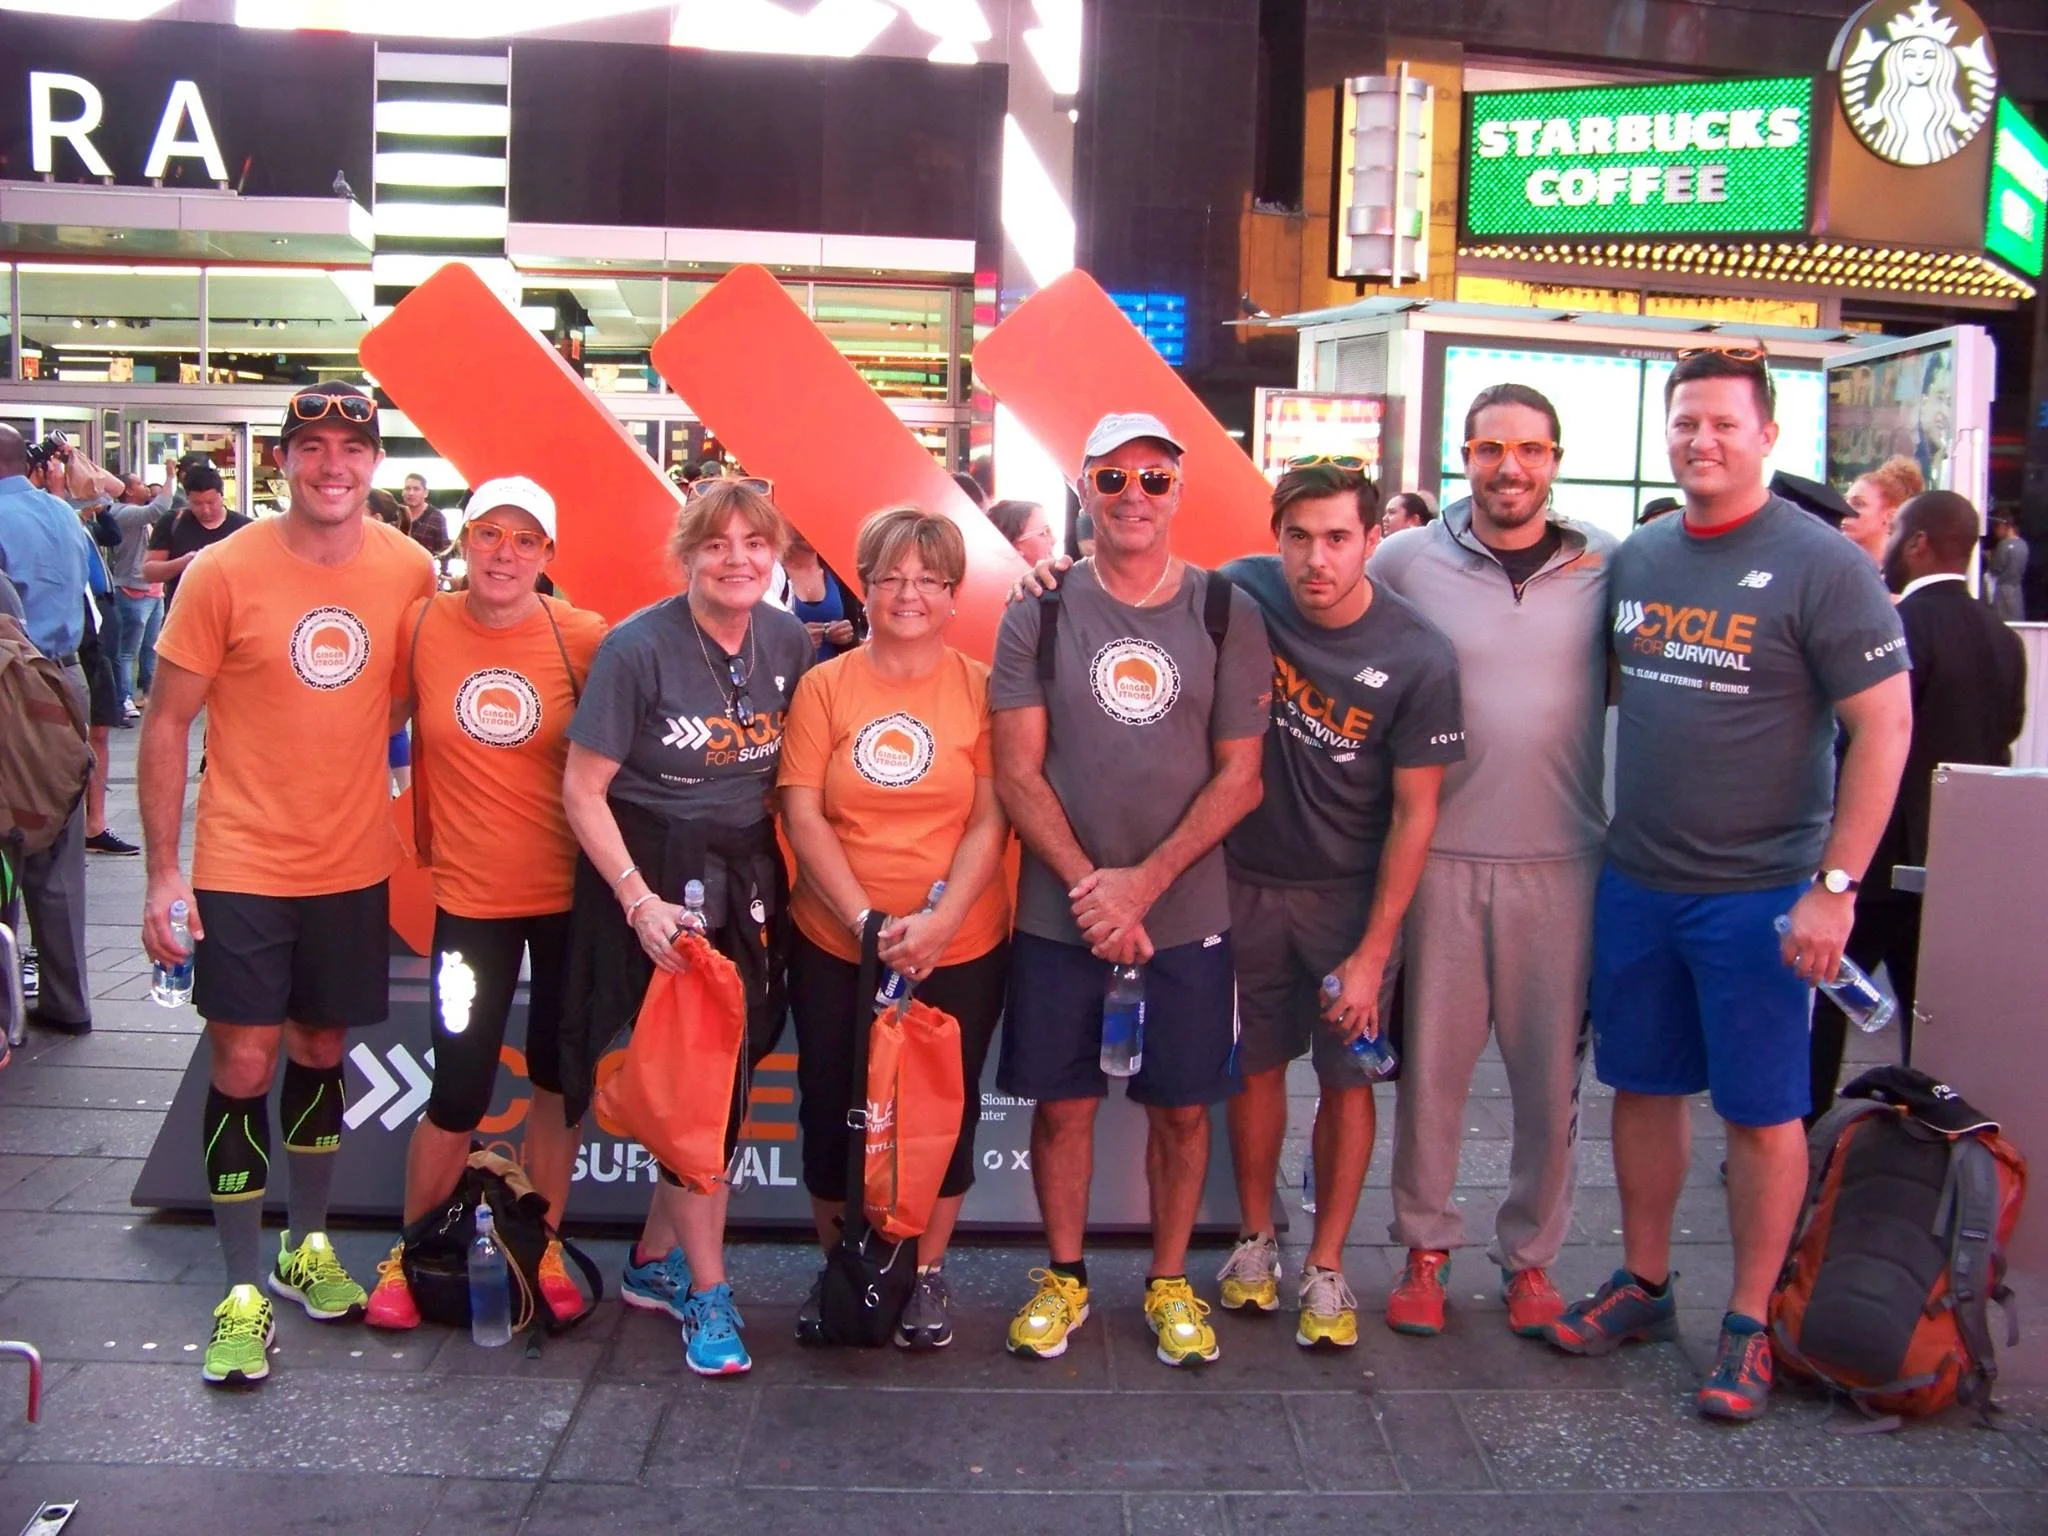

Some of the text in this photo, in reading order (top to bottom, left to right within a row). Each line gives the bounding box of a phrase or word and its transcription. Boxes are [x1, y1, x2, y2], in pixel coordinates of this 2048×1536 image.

[30, 71, 229, 181] RA
[1477, 107, 1801, 158] STARBUCKS
[1526, 164, 1728, 207] COFFEE
[1638, 602, 1757, 654] CYCLE
[1632, 636, 1751, 671] FOR SURVIVAL
[1120, 682, 1150, 692] GINGER
[1636, 668, 1659, 680] SLOAN
[1660, 672, 1703, 689] KETTERING
[1710, 682, 1750, 694] EQUINOX
[1119, 690, 1151, 700] STRONG
[482, 717, 515, 727] STRONG
[483, 709, 514, 719] GINGER
[705, 750, 738, 767] FOR
[876, 757, 909, 767] STRONG
[980, 1093, 1016, 1107] Sloan
